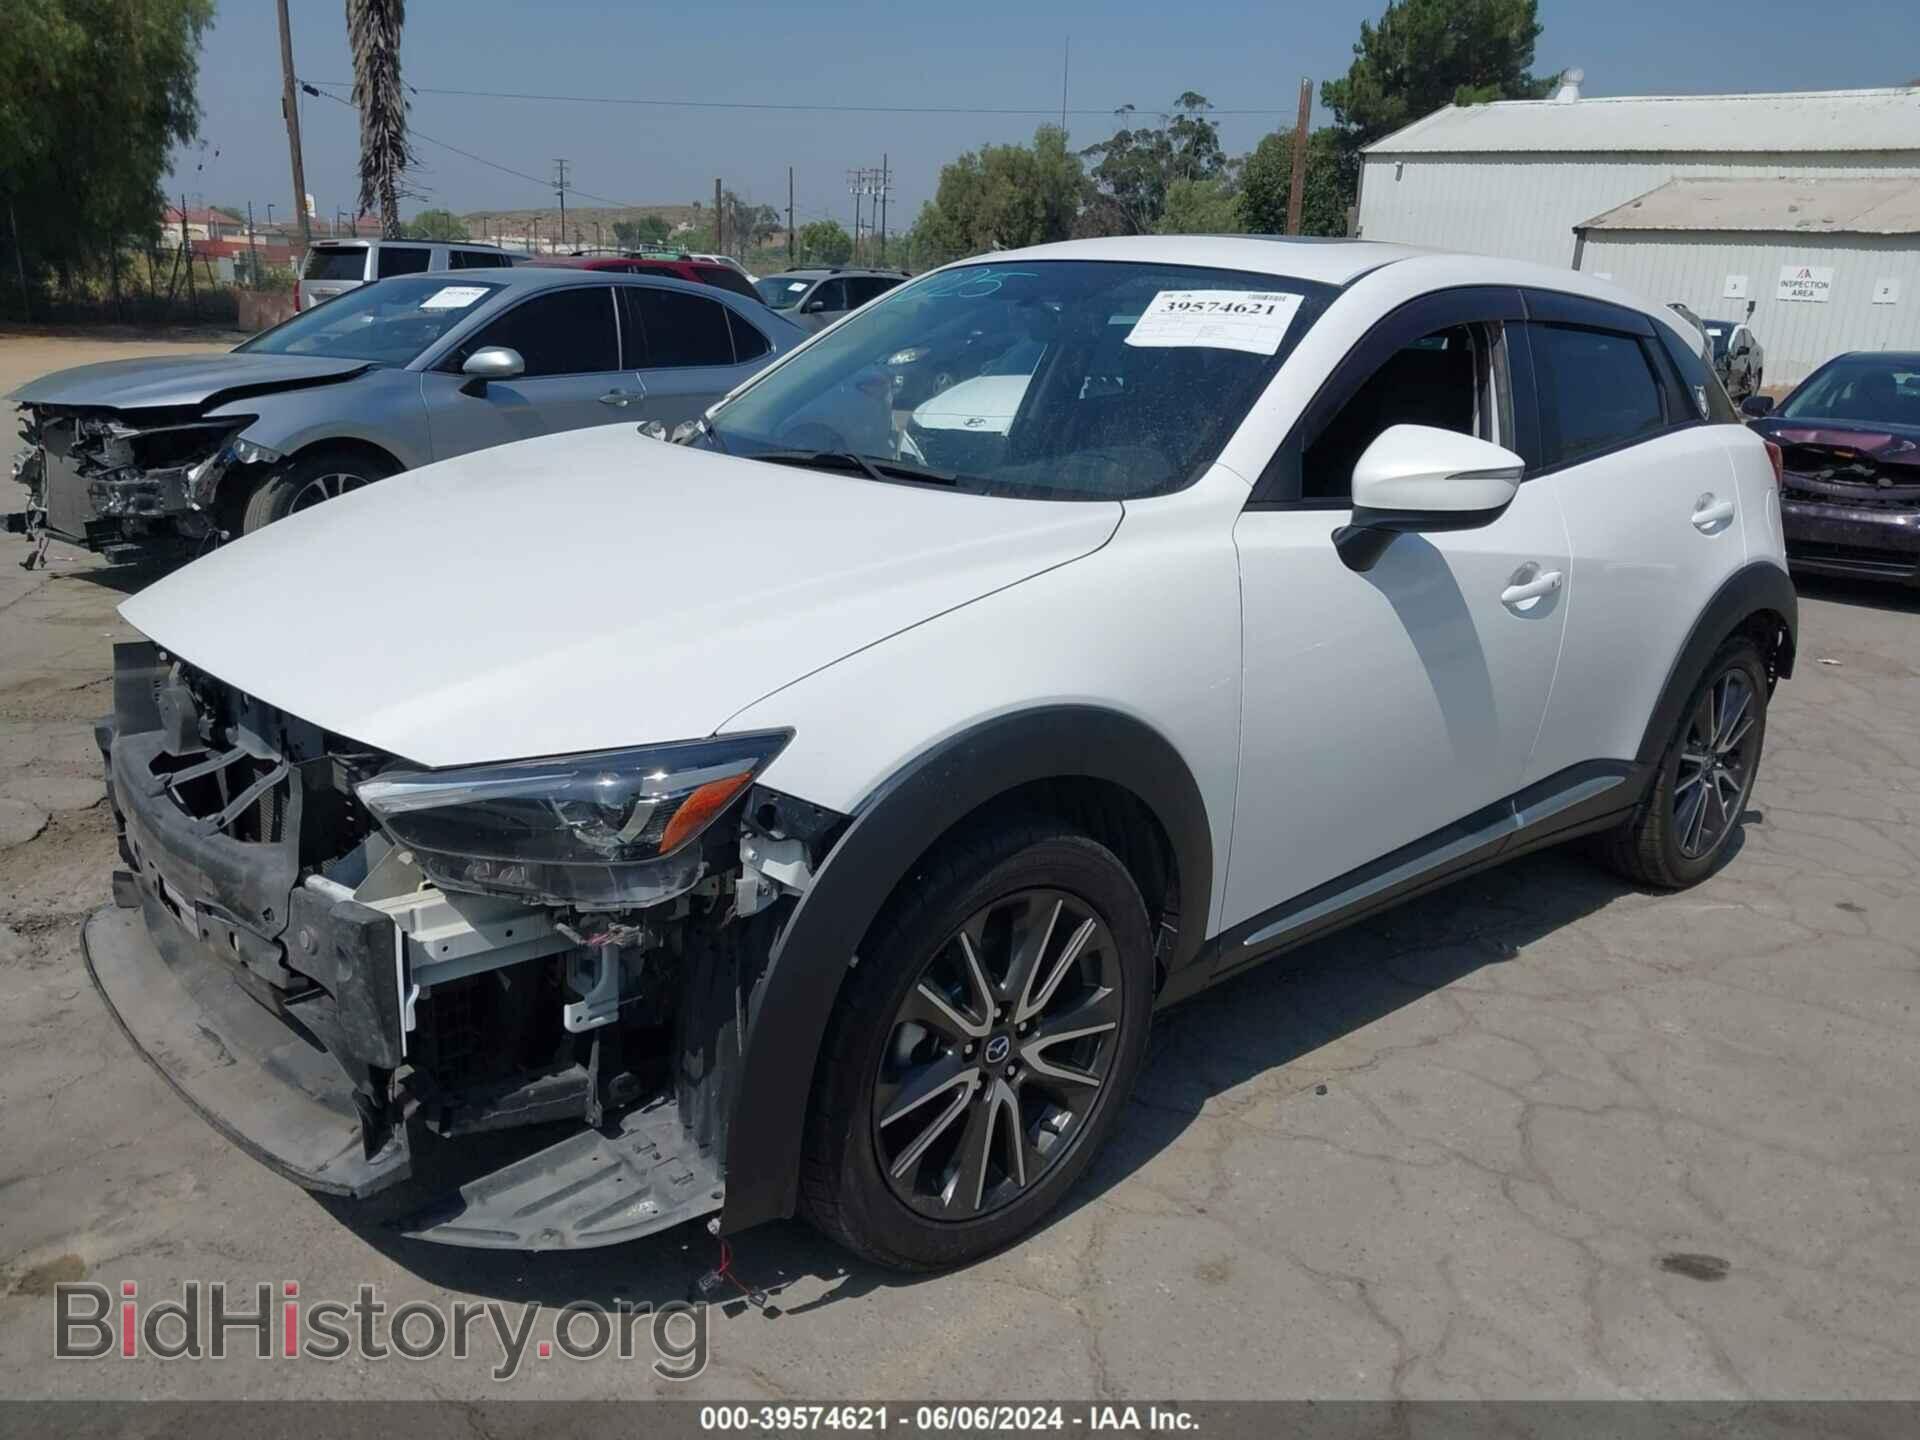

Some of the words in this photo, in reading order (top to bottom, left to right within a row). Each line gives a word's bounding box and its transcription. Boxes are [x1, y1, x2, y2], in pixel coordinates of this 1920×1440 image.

[1780, 280, 1830, 289] INSPECTION
[1791, 289, 1815, 297] AREA
[1160, 301, 1276, 315] 39574621
